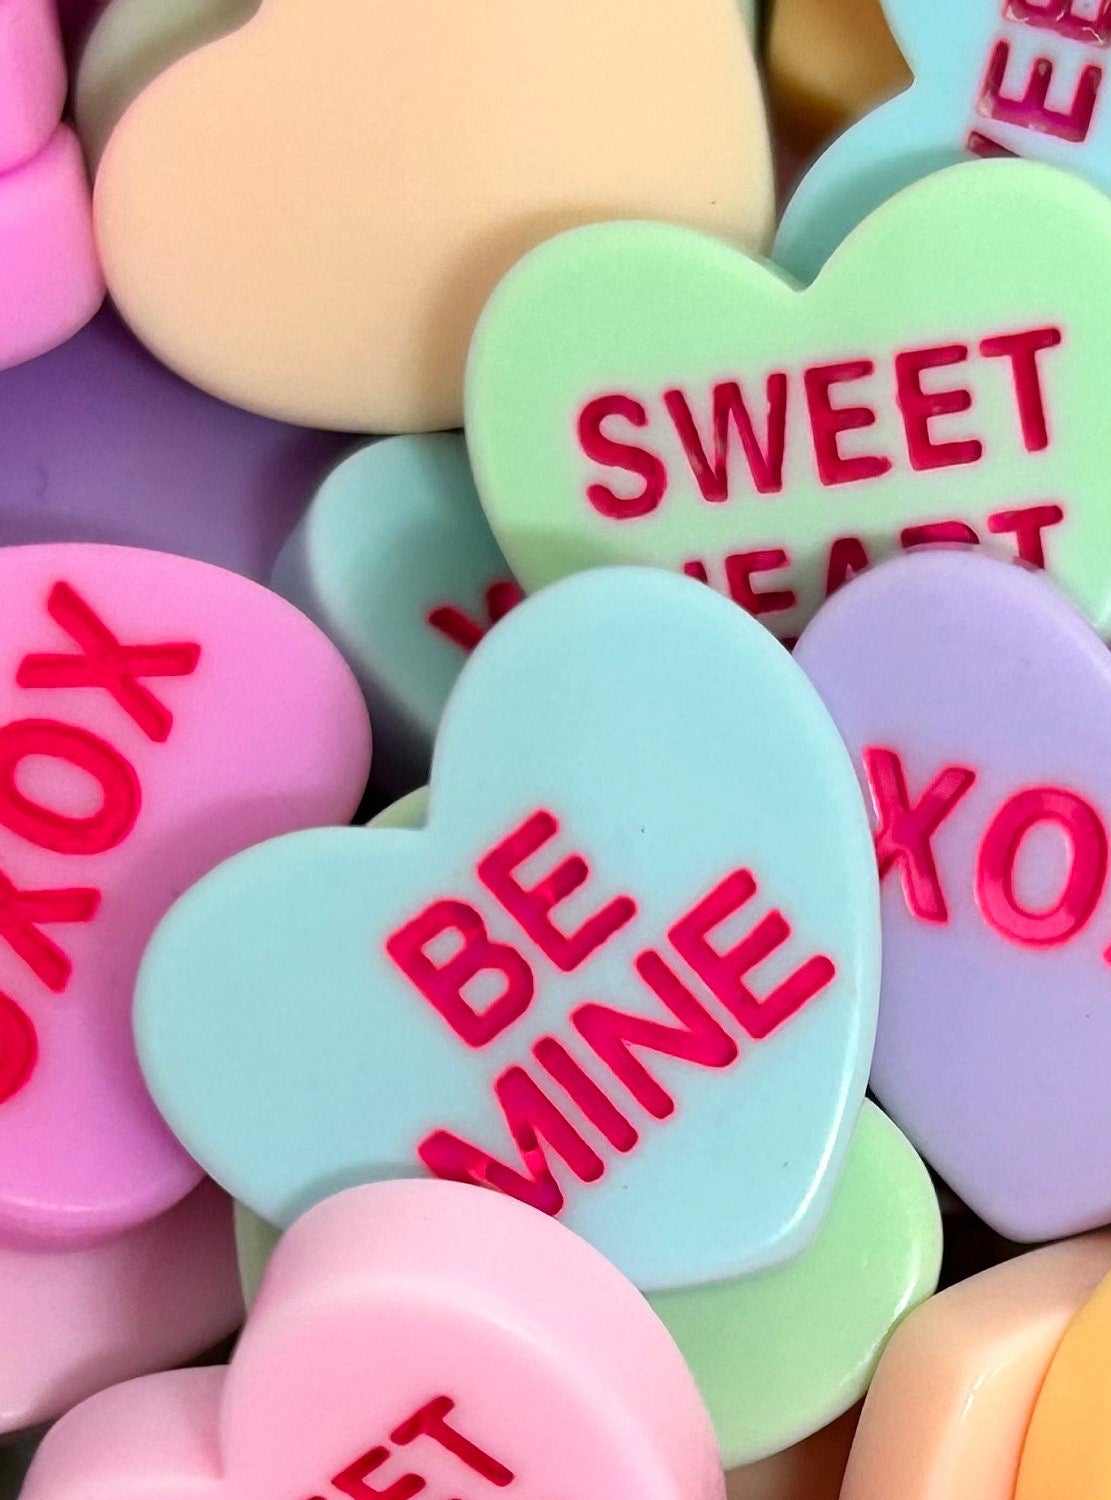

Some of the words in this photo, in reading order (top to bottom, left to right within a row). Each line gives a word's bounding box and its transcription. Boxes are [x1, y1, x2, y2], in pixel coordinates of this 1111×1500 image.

[576, 326, 1062, 519] SWEET
[384, 809, 637, 1048] BE
[418, 867, 836, 1216] MINE
